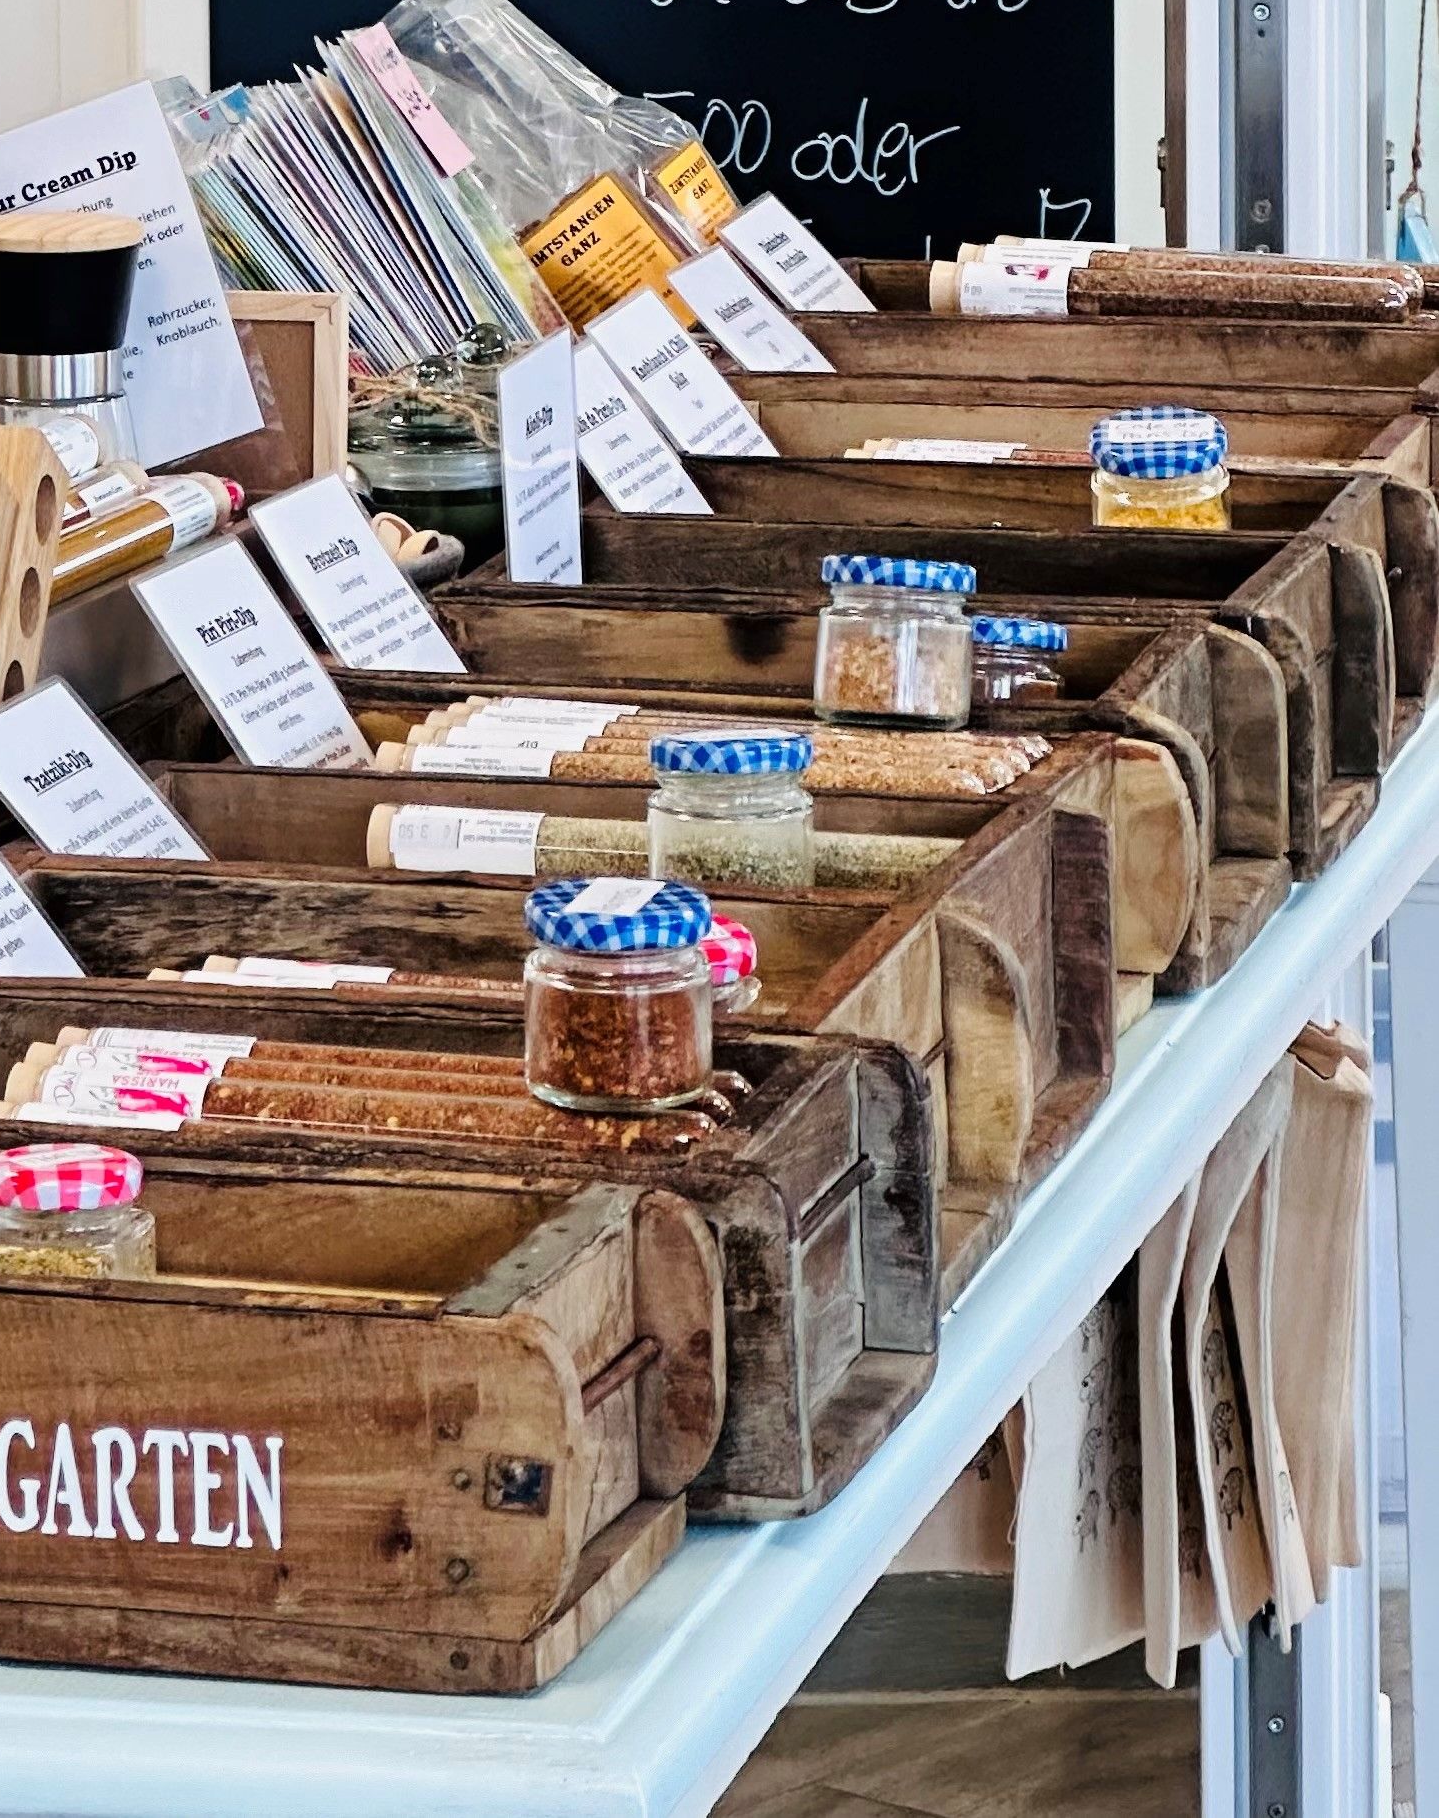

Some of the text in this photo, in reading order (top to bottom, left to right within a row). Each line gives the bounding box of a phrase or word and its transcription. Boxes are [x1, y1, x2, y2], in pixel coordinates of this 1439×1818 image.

[792, 98, 960, 195] oder
[21, 165, 95, 203] Cream
[97, 148, 137, 175] Dip
[158, 223, 184, 242] oder
[530, 193, 616, 268] IMTSTANGEN
[560, 232, 602, 267] GANZ
[148, 297, 216, 328] Rohrzucker,
[157, 316, 222, 346] Knoblauch,
[196, 607, 258, 643] Piri Piri-Dip
[24, 750, 93, 796] Tzatziki-Dip
[112, 1074, 180, 1089] HARISSA
